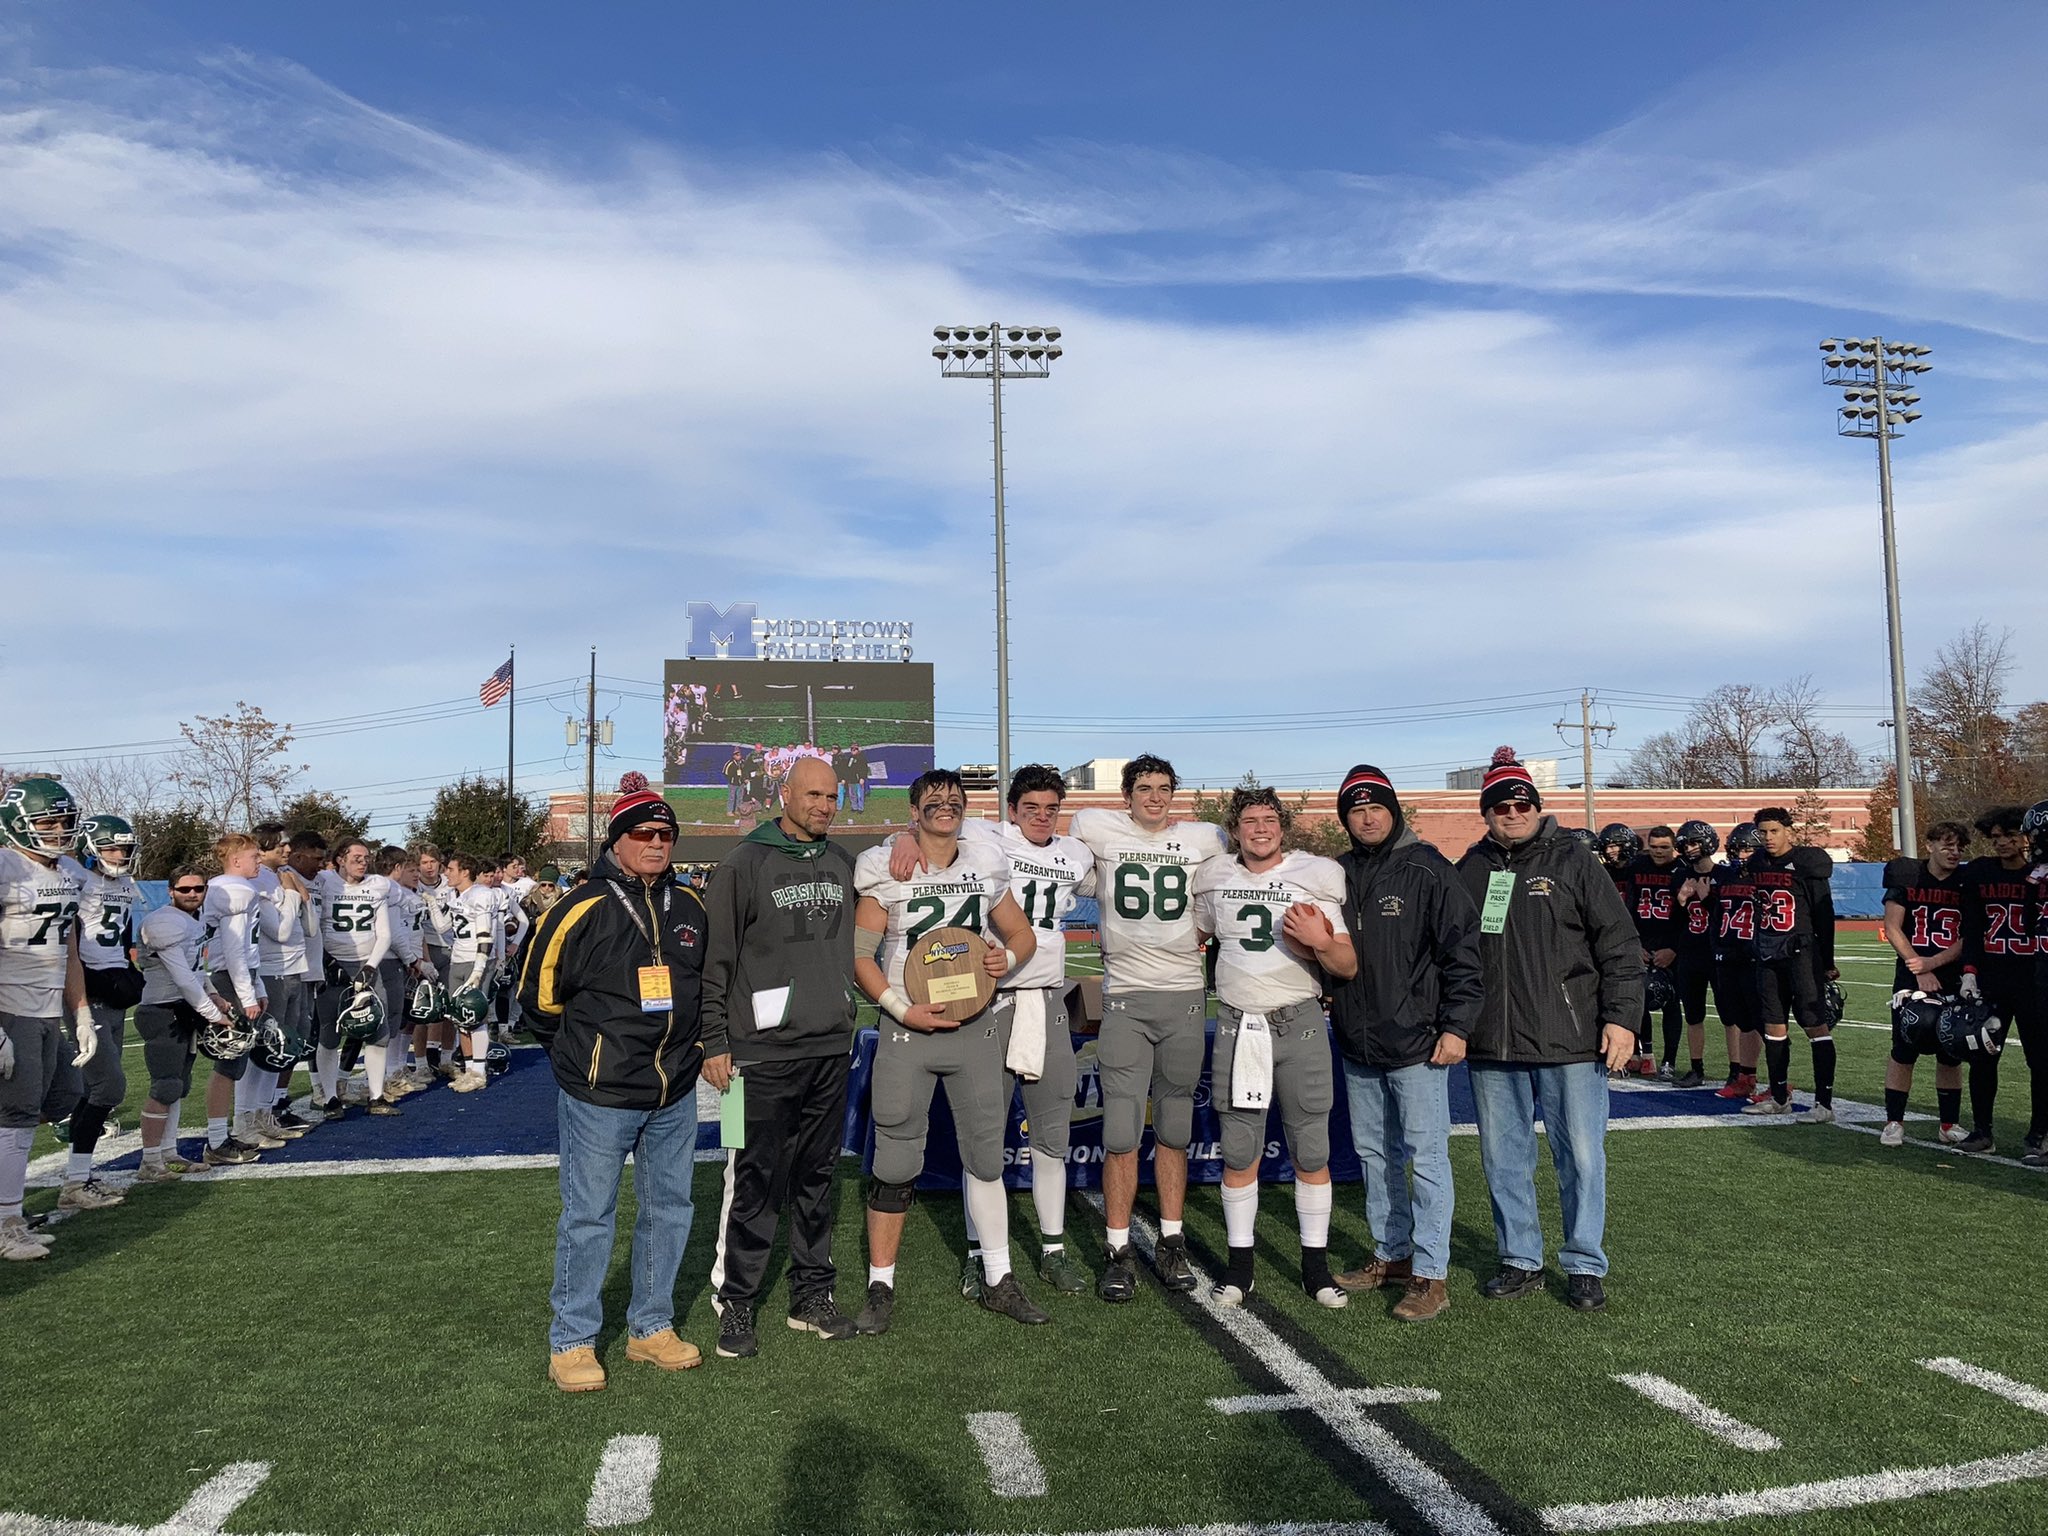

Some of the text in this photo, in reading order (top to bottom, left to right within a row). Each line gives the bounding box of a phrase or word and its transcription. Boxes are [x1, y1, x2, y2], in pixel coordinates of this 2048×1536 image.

[686, 601, 758, 658] M
[764, 619, 914, 639] MIDDLETOWN
[764, 643, 914, 661] FALLER FIELD
[1118, 852, 1190, 866] PLEASANTVILLE
[1012, 861, 1076, 881] PLEASANTVILLE
[770, 882, 844, 909] PLEASANTVILLE
[912, 883, 986, 898] PLEASANTVILLE
[1114, 863, 1189, 921] 68
[1221, 889, 1292, 903] PLEASANTVILLE
[1490, 894, 1506, 902] PASS
[788, 899, 839, 910] FOOTBALL
[1022, 880, 1060, 930] 11
[1637, 888, 1673, 920] 43
[332, 903, 375, 932] 52
[906, 895, 983, 951] 24
[1236, 904, 1275, 952] 3
[1482, 915, 1504, 924] FALLER
[1482, 924, 1500, 932] FIELD
[1911, 905, 1963, 949] 13
[1983, 903, 2037, 956] 25
[1002, 1145, 1107, 1167] SEION
